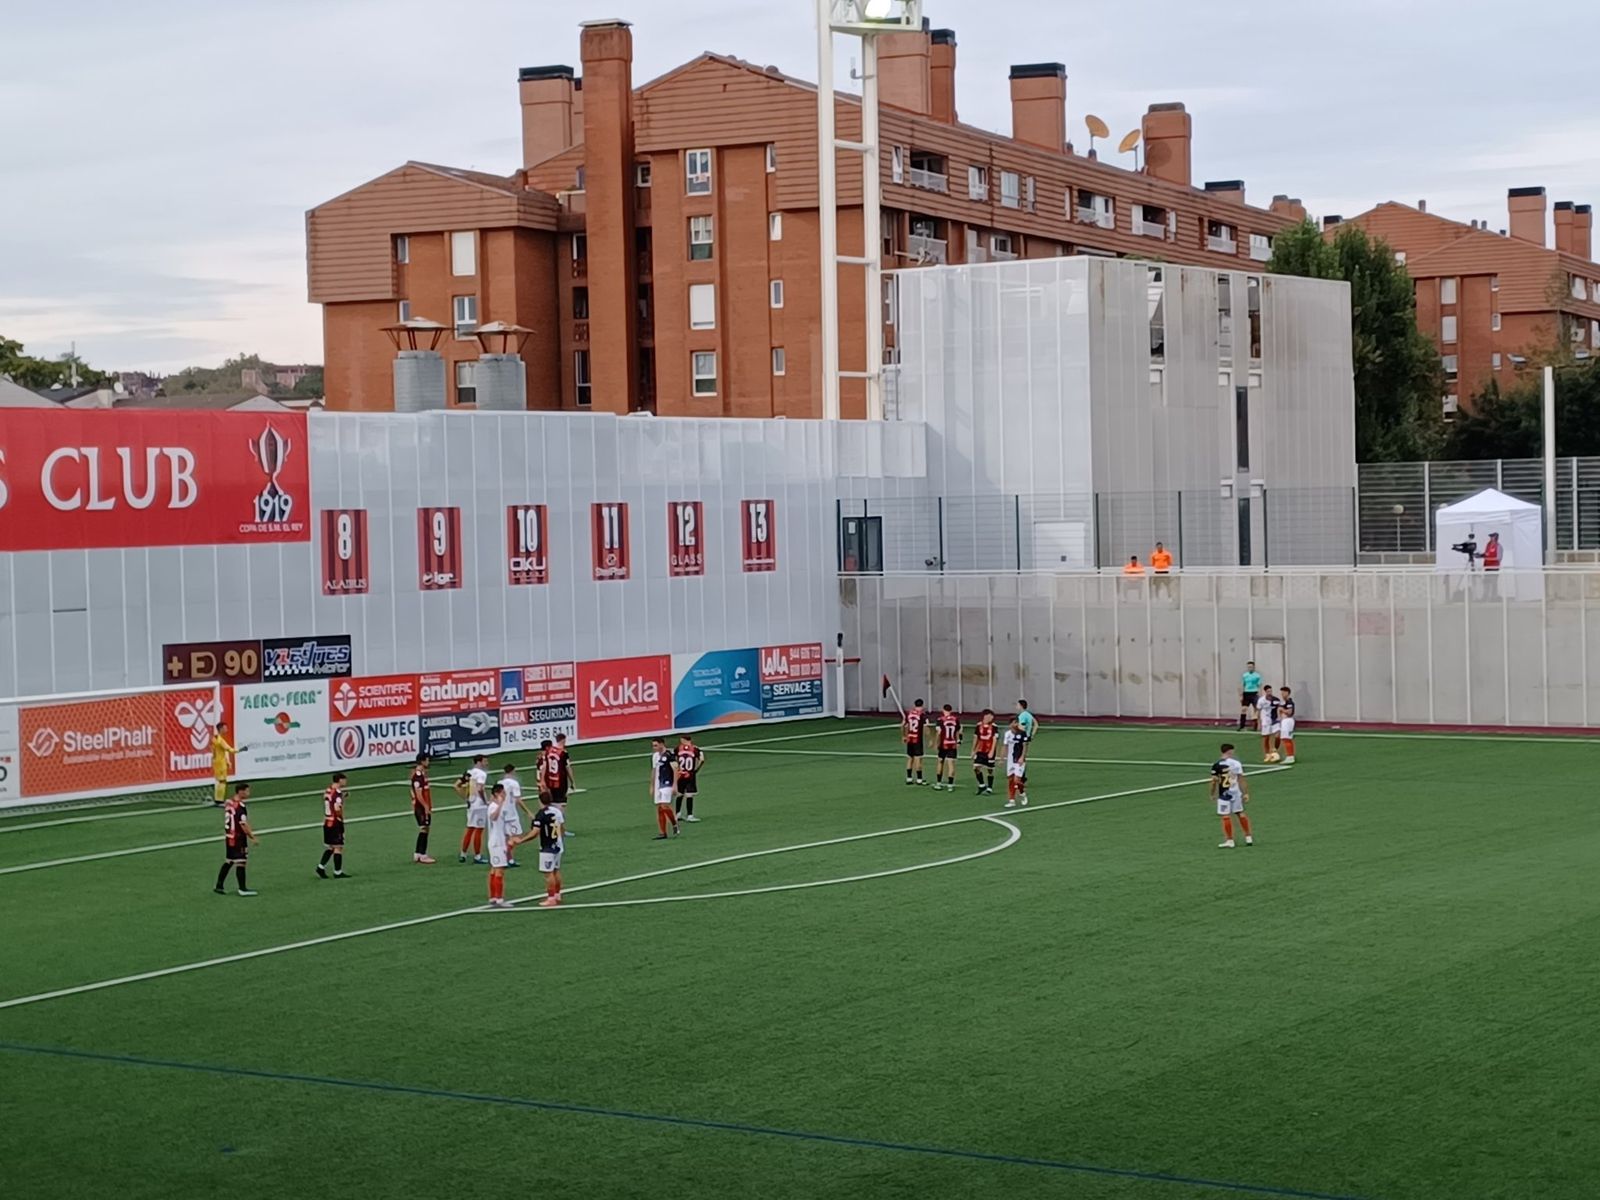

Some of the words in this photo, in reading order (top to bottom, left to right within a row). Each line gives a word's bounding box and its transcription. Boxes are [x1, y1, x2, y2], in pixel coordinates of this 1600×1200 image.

[41, 446, 198, 512] CLUB
[253, 494, 293, 523] 1919
[433, 511, 446, 556] 9
[517, 508, 538, 553] 10
[602, 506, 619, 549] 11
[676, 504, 695, 546] 12
[749, 503, 767, 543] 13
[338, 513, 352, 560] 8
[510, 557, 546, 571] OKU
[671, 553, 702, 565] GLASS
[224, 649, 259, 676] 90
[358, 682, 413, 697] SCIENTIFIC
[420, 677, 495, 702] endurpol
[590, 676, 658, 708] Kukla
[773, 681, 811, 696] SERVACE
[529, 706, 575, 722] SEGURIDAD
[63, 725, 157, 753] SteelPhalt
[368, 720, 416, 739] NUTEC
[504, 730, 519, 743] Tel.
[521, 728, 538, 741] 946
[540, 727, 551, 739] 56
[566, 725, 574, 736] 11
[368, 738, 416, 757] PROCAL
[170, 750, 213, 772] humm
[679, 756, 693, 771] 20
